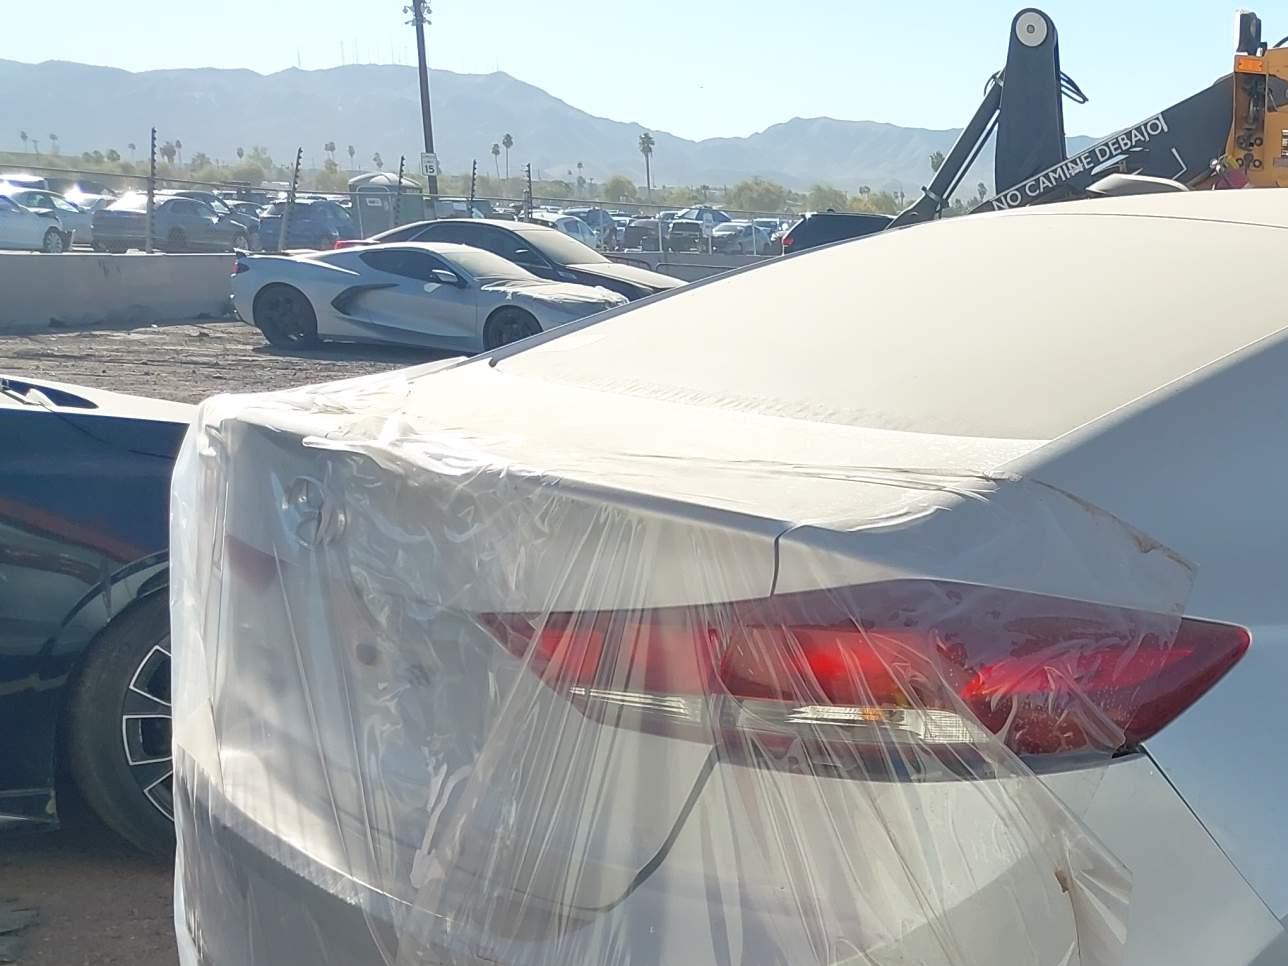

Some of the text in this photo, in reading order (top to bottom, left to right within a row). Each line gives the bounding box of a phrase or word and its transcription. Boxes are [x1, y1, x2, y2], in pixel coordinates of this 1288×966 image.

[424, 164, 435, 174] 15
[992, 117, 1163, 211] NO CAMINE DEBAJO
